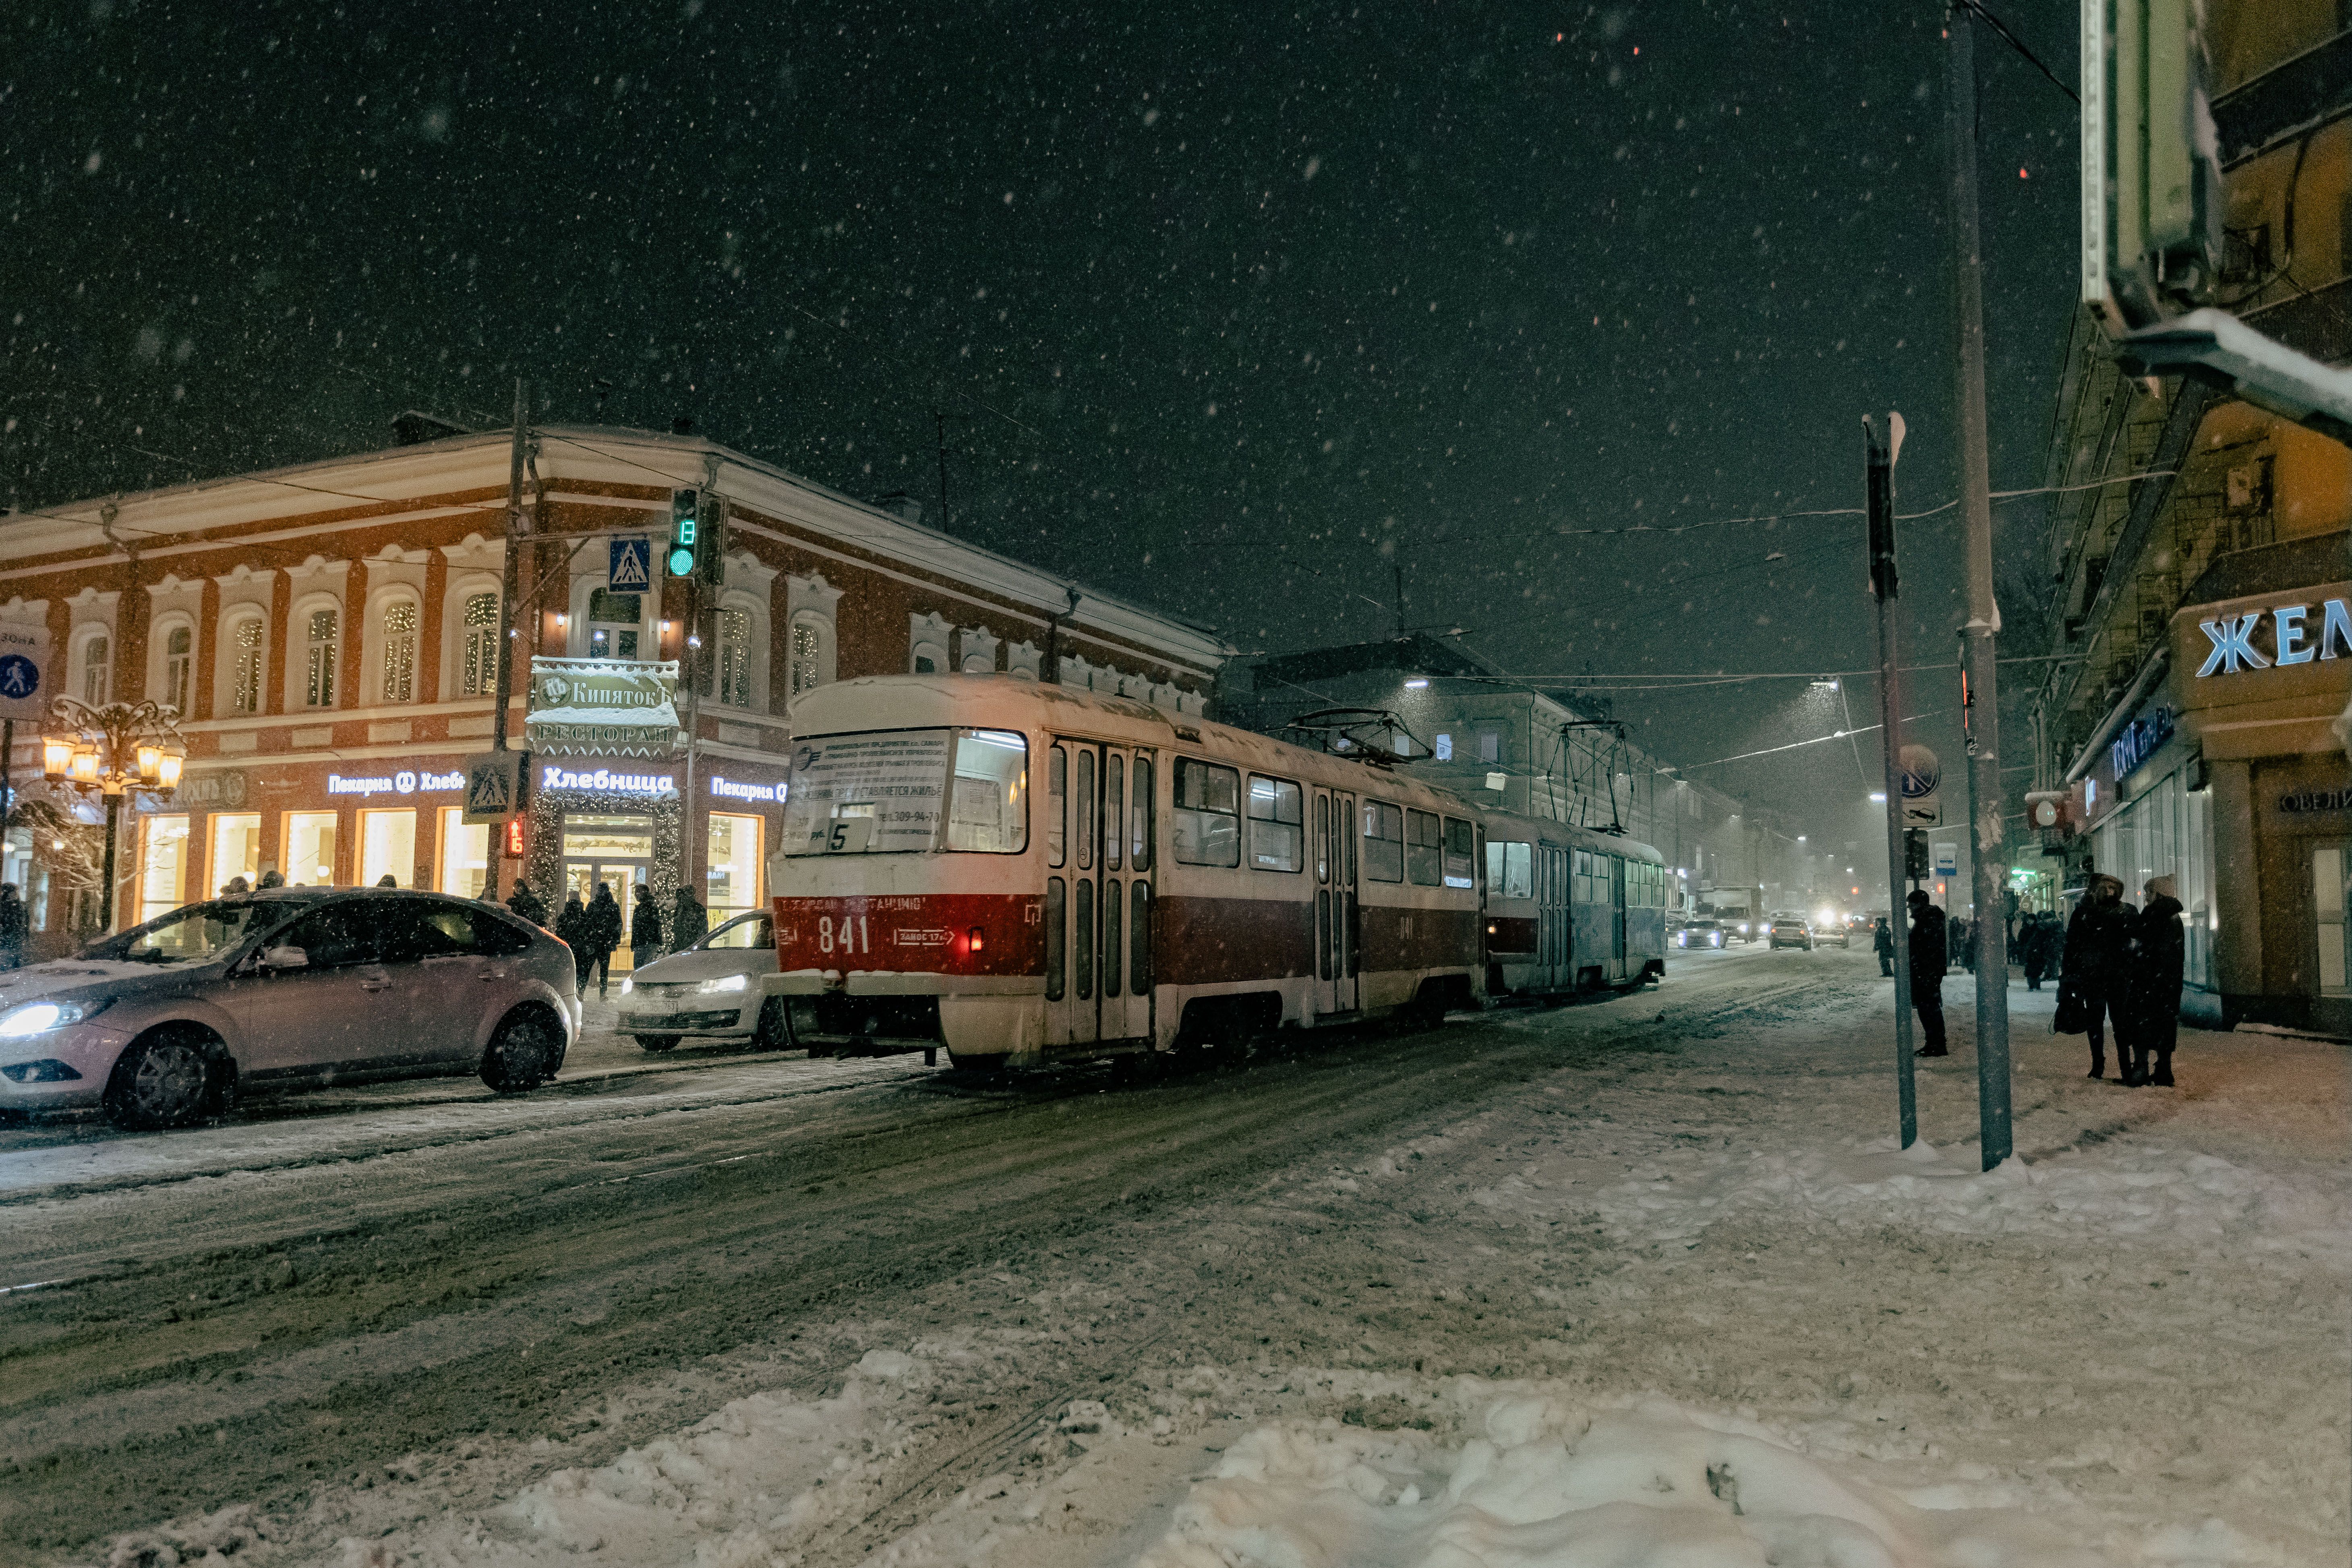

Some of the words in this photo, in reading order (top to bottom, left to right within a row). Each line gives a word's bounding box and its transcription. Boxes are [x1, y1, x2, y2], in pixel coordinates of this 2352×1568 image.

[680, 521, 695, 544] 13
[329, 775, 393, 797] Пекарня
[544, 767, 673, 793] Хлебница
[713, 777, 774, 802] Пекарня
[512, 837, 523, 853] 16
[830, 824, 849, 851] 5
[819, 916, 869, 953] 841
